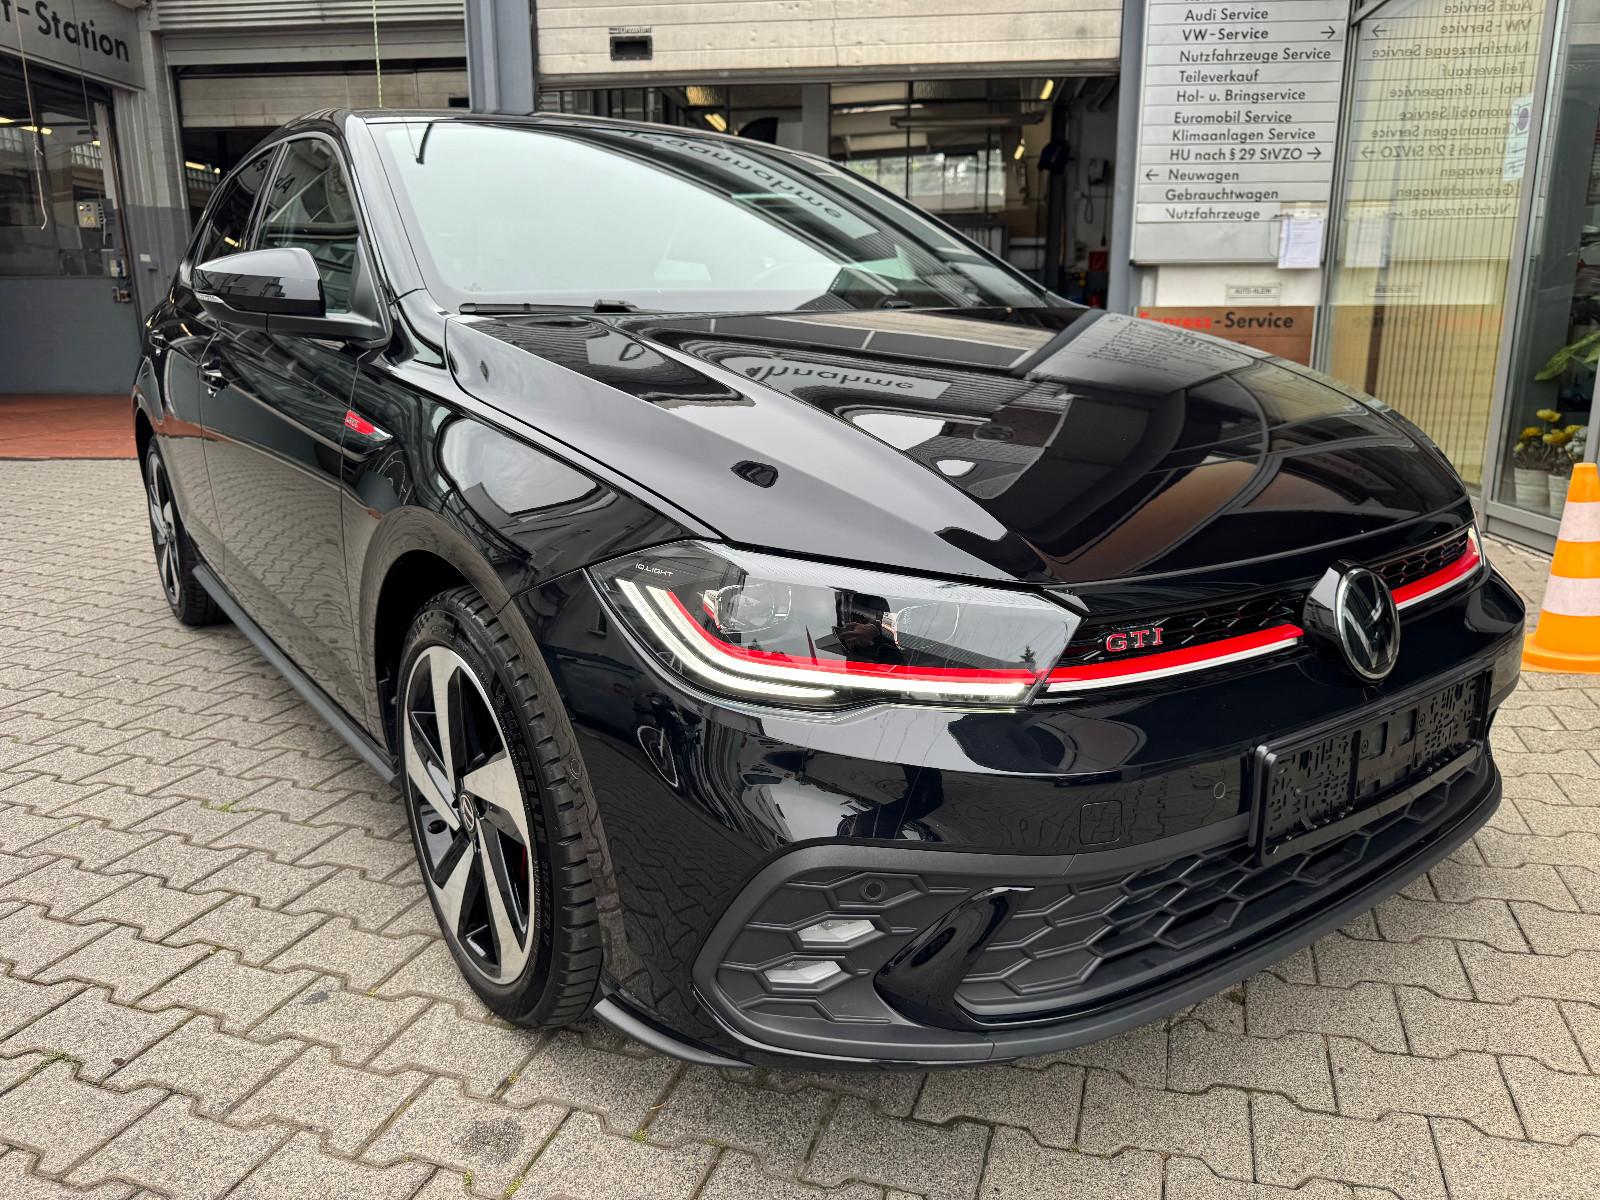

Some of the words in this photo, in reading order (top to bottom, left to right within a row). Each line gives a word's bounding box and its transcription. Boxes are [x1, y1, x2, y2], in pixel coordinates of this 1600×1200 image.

[1184, 9, 1217, 22] Audi
[1221, 8, 1269, 21] Service
[1182, 28, 1269, 41] VW-Service
[1179, 49, 1278, 63] Nutzfahrzeuge
[1282, 48, 1331, 60] Service
[1179, 69, 1260, 83] Teileverkauf
[1176, 89, 1204, 102] Hol-
[1209, 92, 1220, 102] u.
[1225, 88, 1306, 104] Bringservice
[1174, 111, 1240, 124] Euromobil
[1244, 111, 1292, 123] Service
[1172, 129, 1264, 144] Klimaanlagen
[1268, 128, 1316, 140] Service
[1170, 149, 1190, 161] HU
[1195, 148, 1226, 161] nach
[1260, 148, 1302, 160] StVZO
[1168, 169, 1240, 183] Neuwagen
[1165, 188, 1279, 203] Gebrauchtwagen
[1165, 207, 1261, 222] Nutzfahrzeuge
[1106, 627, 1164, 652] GTI
